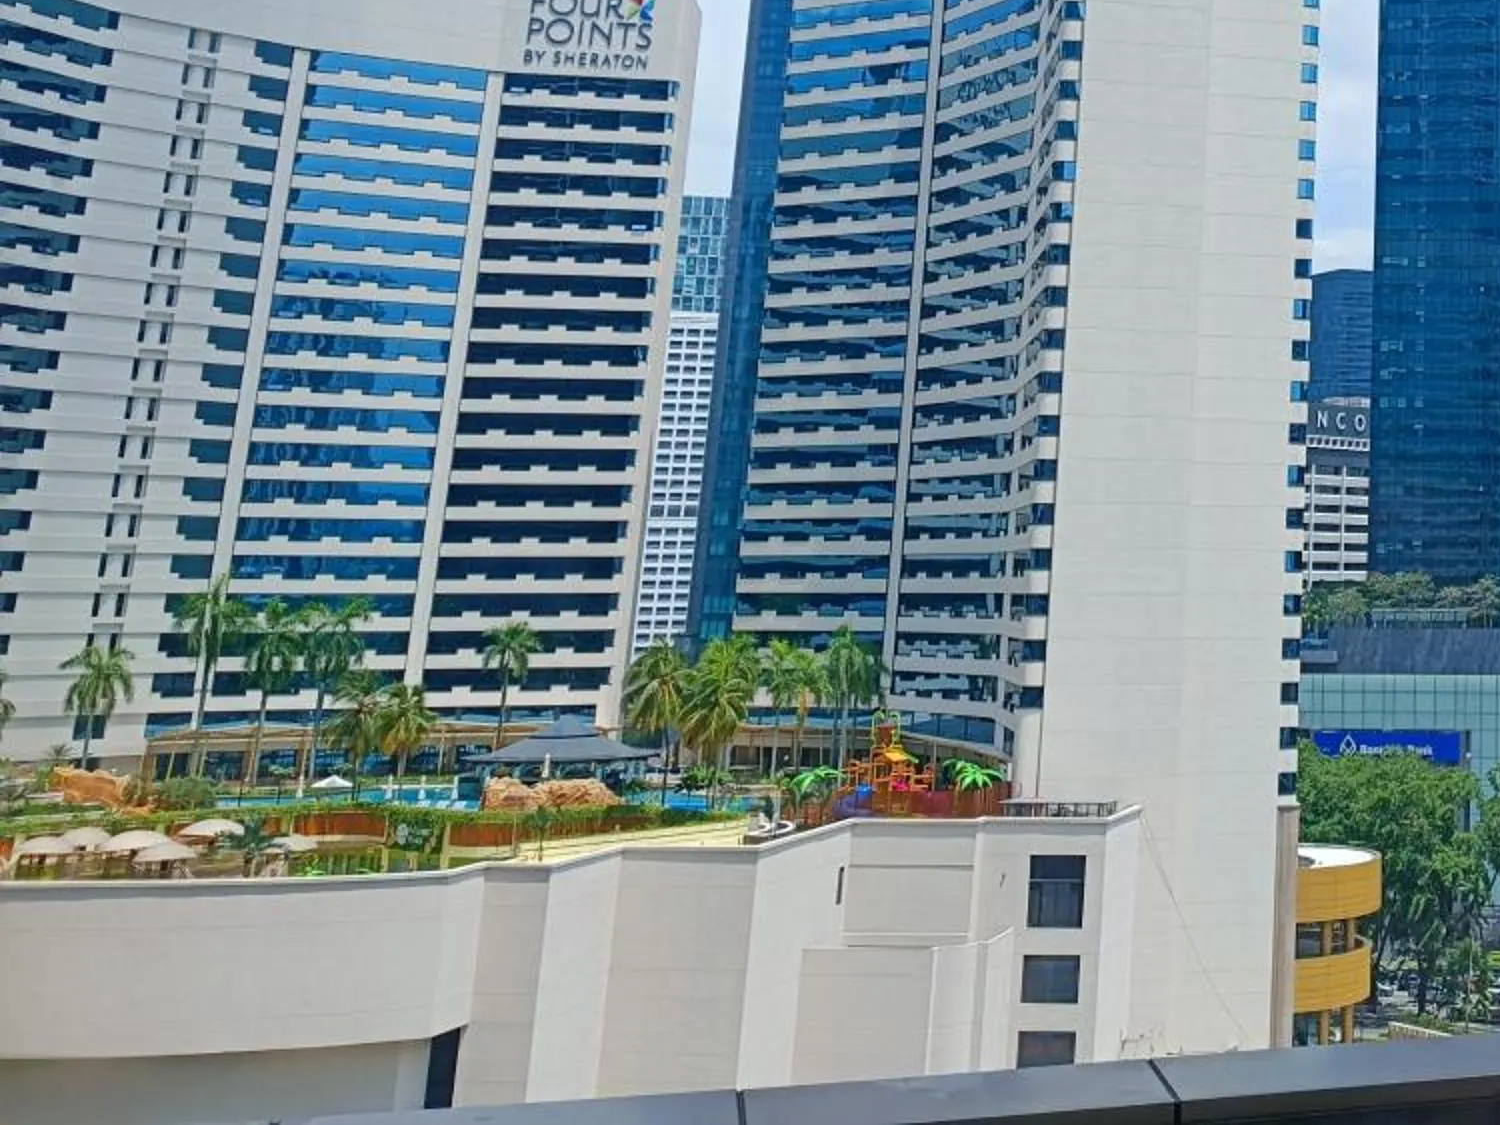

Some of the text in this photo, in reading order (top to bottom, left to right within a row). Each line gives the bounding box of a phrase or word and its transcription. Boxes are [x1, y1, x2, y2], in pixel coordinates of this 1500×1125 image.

[526, 16, 653, 52] POINTS
[522, 48, 649, 72] BY SHERATON
